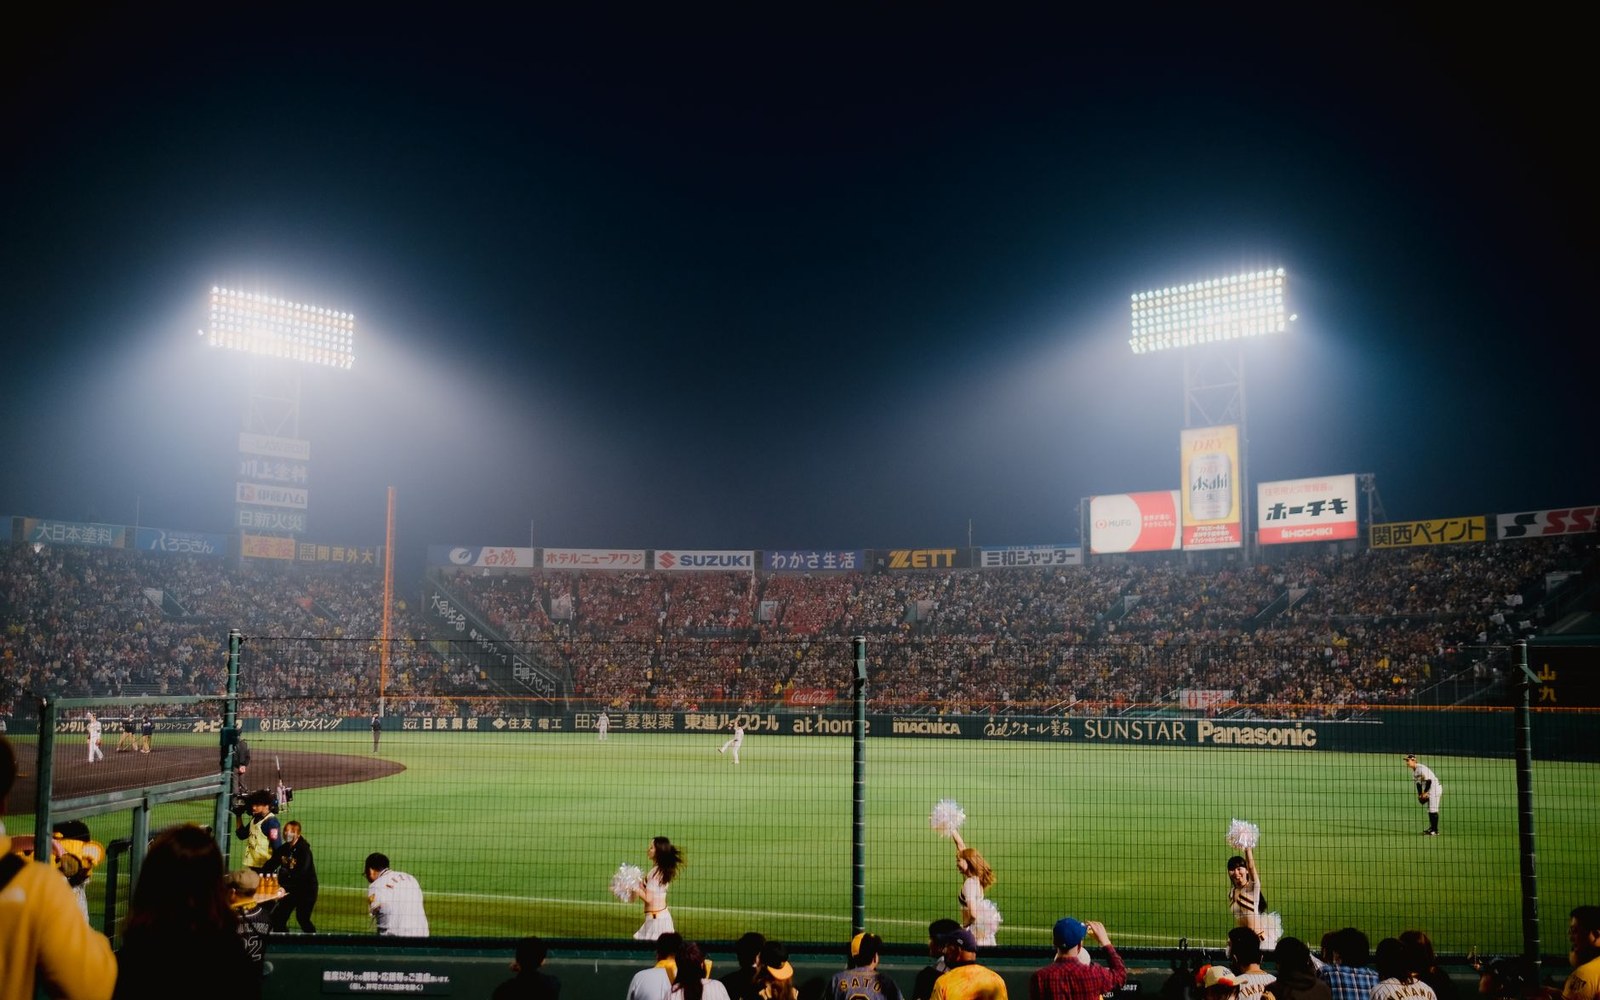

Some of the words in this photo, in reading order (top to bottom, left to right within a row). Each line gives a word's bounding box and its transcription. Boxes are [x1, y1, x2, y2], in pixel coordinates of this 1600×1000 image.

[1192, 472, 1227, 491] Asahi
[1266, 498, 1348, 520] ホーチキ
[239, 511, 302, 531] 日新火災
[1109, 519, 1132, 527] MUFG
[1542, 507, 1600, 534] SS
[36, 522, 112, 544] 大日本塗料
[1287, 527, 1333, 537] HOCHIKI
[1373, 519, 1484, 546] 関西ペイント
[168, 537, 215, 554] ろうきん
[317, 544, 373, 564] 関西外大
[484, 549, 517, 566] 白鶴
[546, 553, 643, 565] ホテルニューアワジ
[680, 555, 750, 566] SUZUKI
[771, 552, 856, 569] わかさ生活
[888, 549, 957, 568] ZETT
[987, 550, 1075, 566] 三和シャッター
[431, 592, 466, 631] 大同生命
[272, 717, 342, 731] 日本ハウズイング
[401, 721, 419, 730] SGL
[422, 717, 478, 730] 日鉄鋼板
[508, 717, 562, 730] 住友電工
[793, 717, 813, 733] at
[1085, 719, 1186, 741] SUNSTAR
[1197, 720, 1317, 747] Panasonic
[839, 977, 882, 993] SATO
